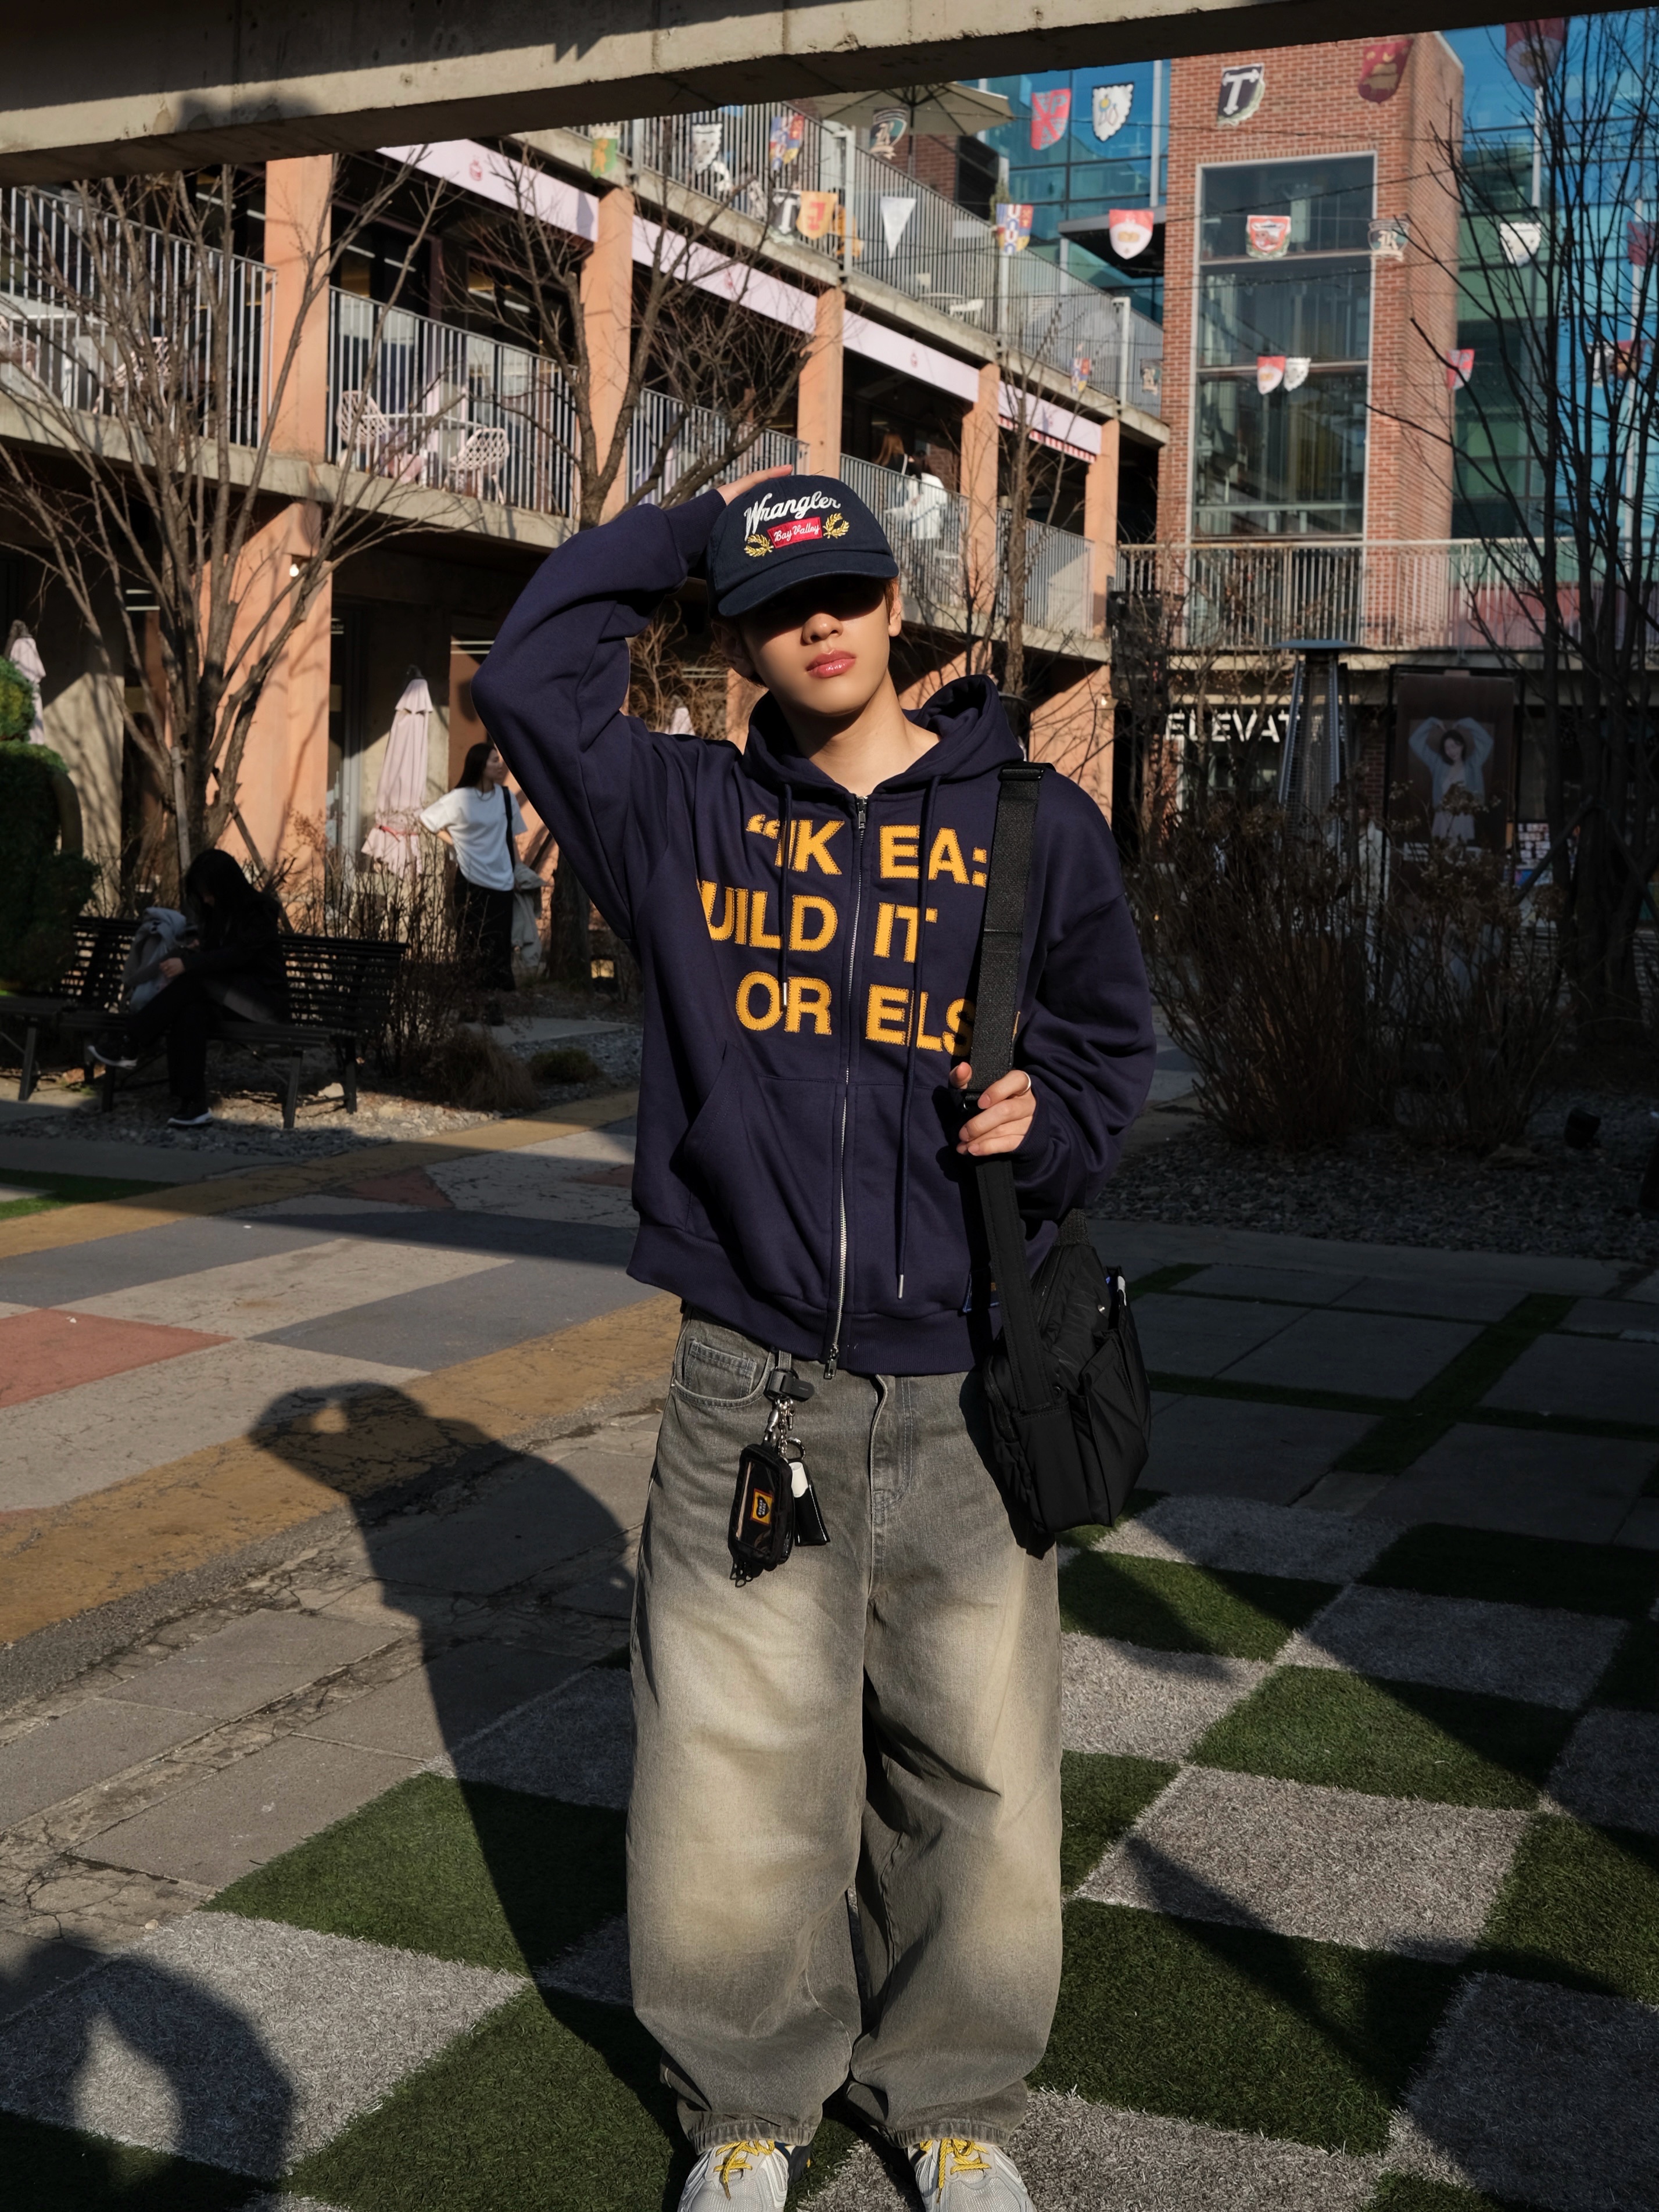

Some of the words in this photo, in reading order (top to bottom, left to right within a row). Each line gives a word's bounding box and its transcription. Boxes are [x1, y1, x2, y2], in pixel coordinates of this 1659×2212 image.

[744, 491, 841, 542] Wrangler
[773, 530, 792, 542] Bay
[793, 522, 820, 535] Valley
[696, 879, 839, 952] UILD
[736, 971, 833, 1035] OR
[865, 984, 1021, 1057] ELS
